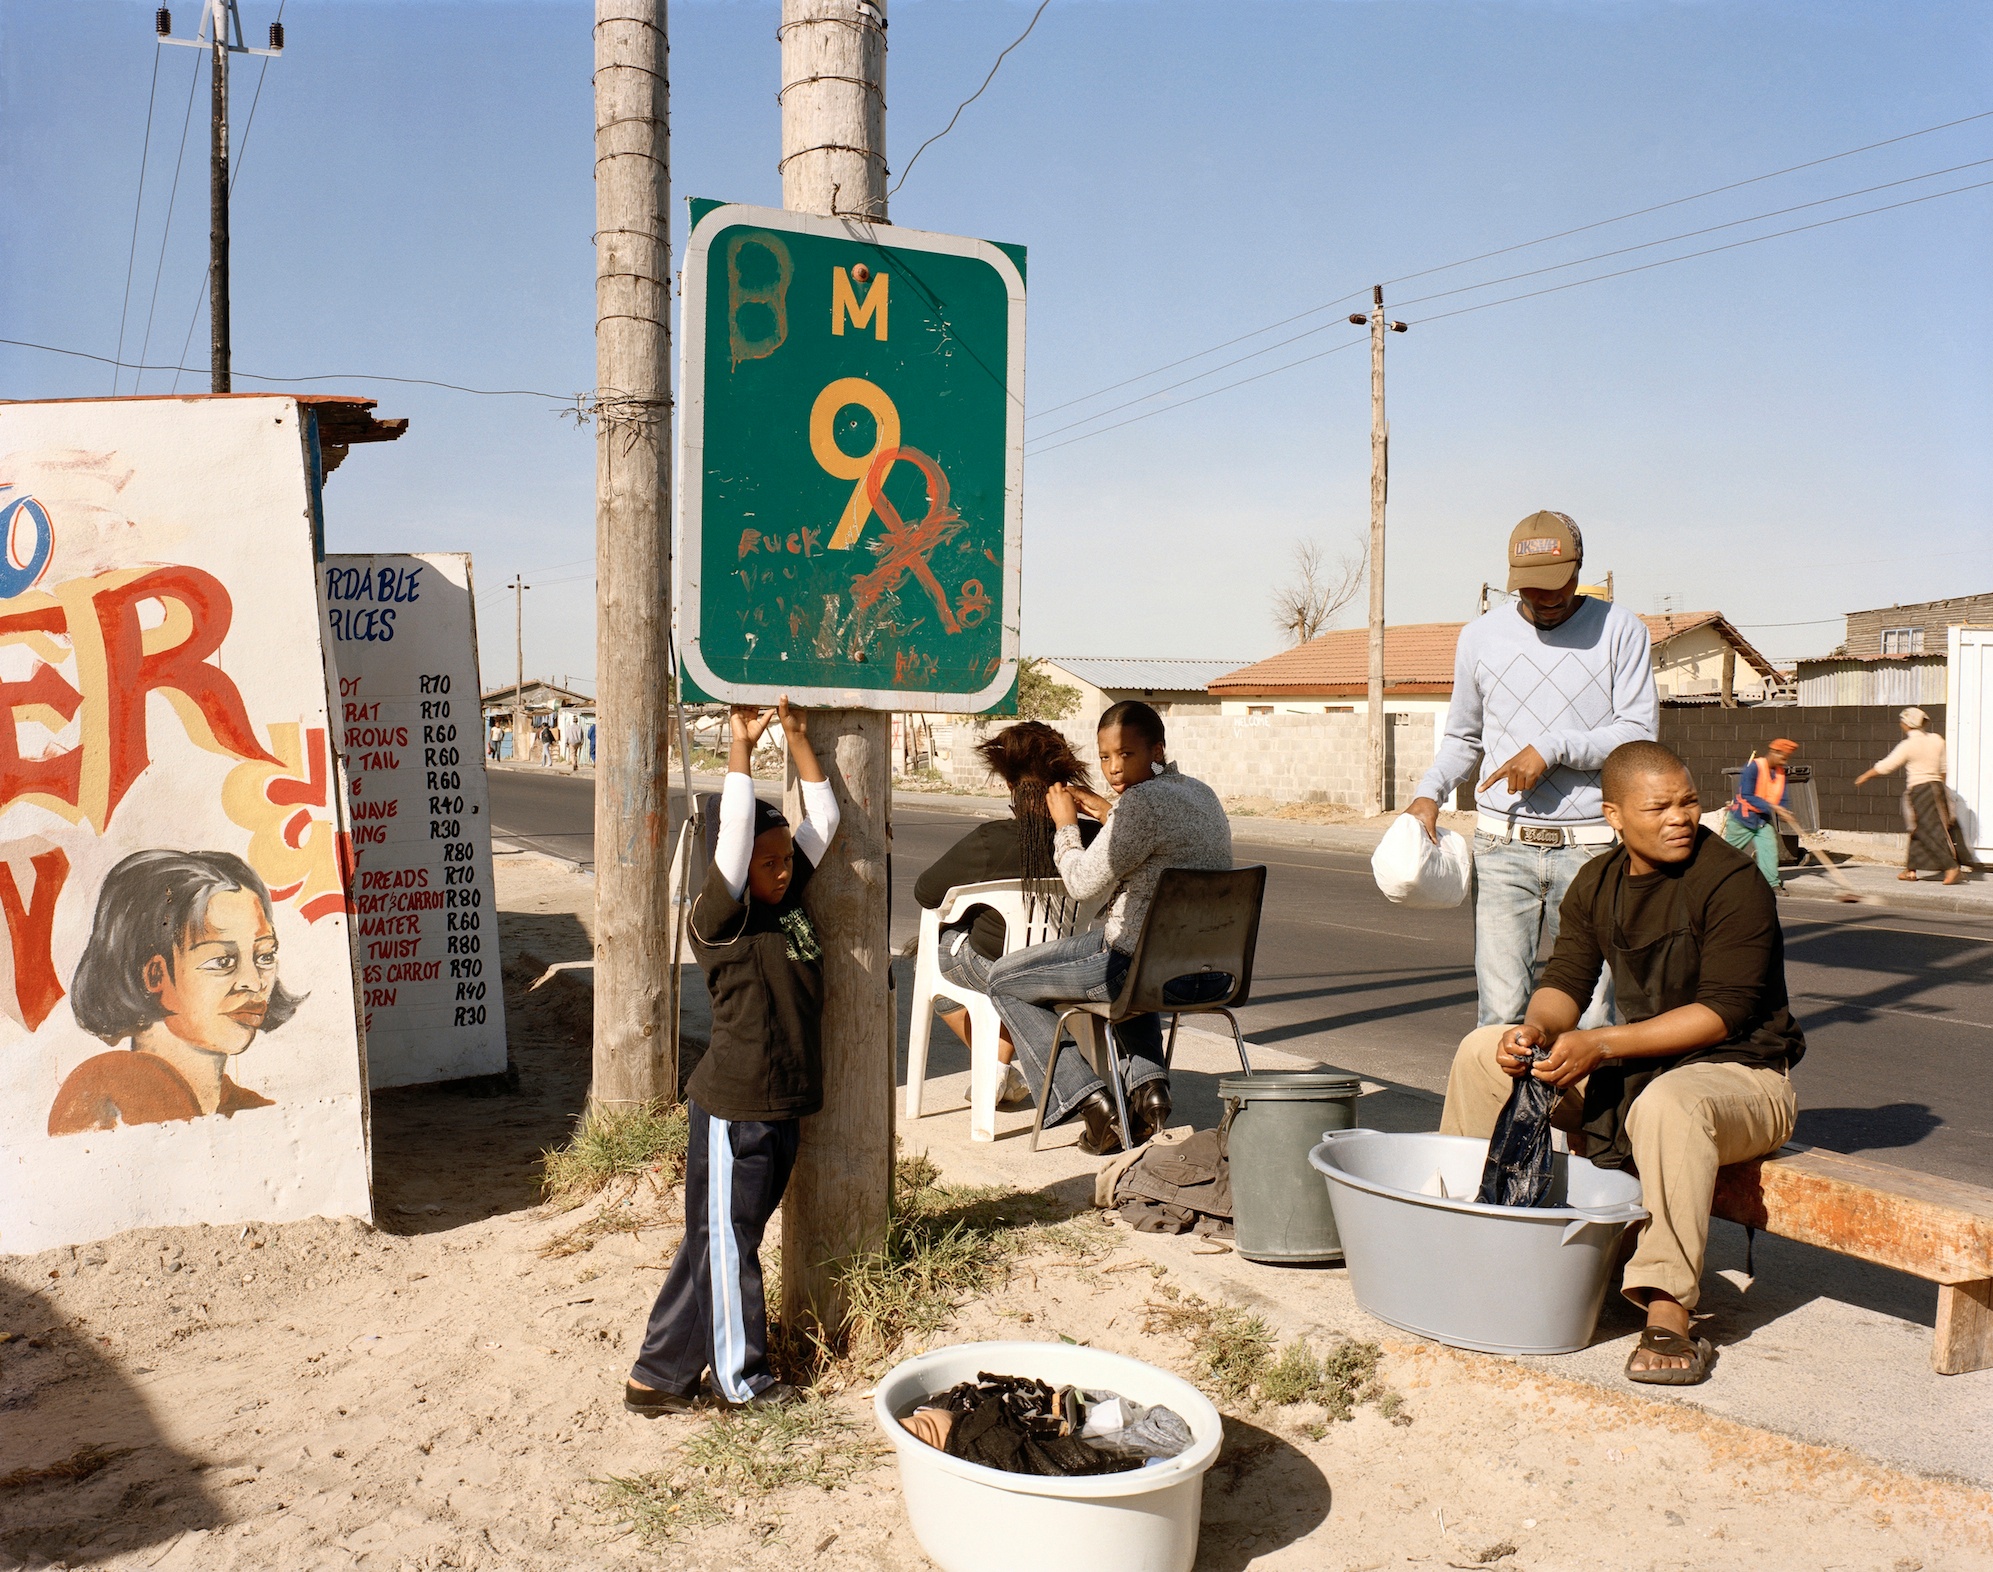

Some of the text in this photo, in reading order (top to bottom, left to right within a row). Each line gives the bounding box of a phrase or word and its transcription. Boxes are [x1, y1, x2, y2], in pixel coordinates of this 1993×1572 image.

[831, 265, 889, 341] M
[809, 376, 902, 551] 9
[419, 674, 451, 695] R70
[420, 700, 450, 720] R70
[423, 724, 457, 745] R60
[358, 750, 400, 771] TAIL
[424, 746, 460, 768] R60
[427, 770, 461, 791] R60
[428, 795, 464, 815] R40
[429, 819, 460, 840] R30
[443, 842, 474, 862] R80
[361, 865, 475, 890] DREADS R70
[445, 888, 481, 909] R80
[446, 911, 480, 932] R60
[367, 934, 481, 961] TWIST R80
[386, 960, 442, 983] CARROT
[450, 958, 483, 979] R90
[455, 982, 487, 1002] R40
[453, 1004, 487, 1027] R30
